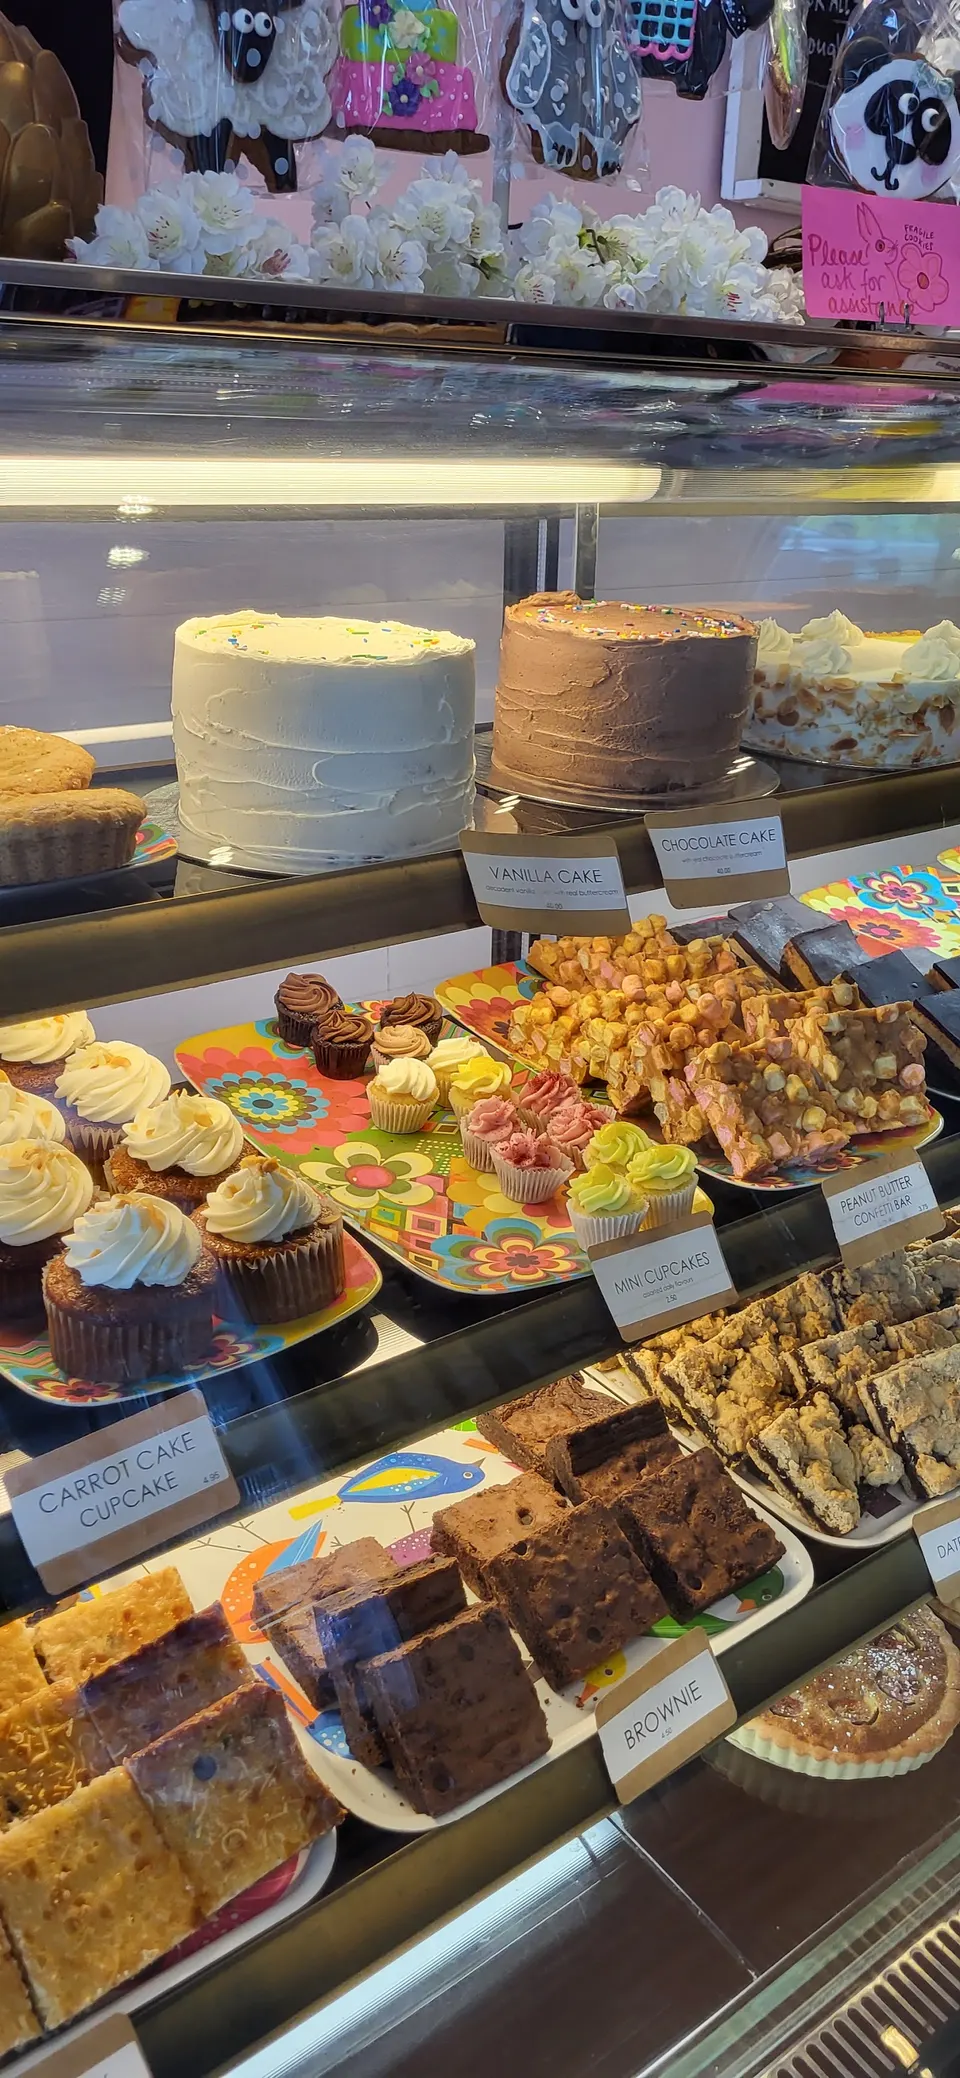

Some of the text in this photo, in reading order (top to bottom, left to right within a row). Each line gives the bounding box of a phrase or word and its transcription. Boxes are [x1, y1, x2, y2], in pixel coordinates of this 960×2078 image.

[904, 224, 935, 240] FRAGILE
[904, 234, 934, 251] COOKIES
[808, 233, 870, 267] Please
[821, 266, 887, 299] ask for
[661, 828, 777, 852] CHOCOLATE CAKE
[488, 865, 604, 884] VANILLA CAKE
[840, 1174, 913, 1214] PEANUT BUTTER
[853, 1202, 894, 1227] CONFETTI
[893, 1194, 913, 1211] BAR
[614, 1250, 710, 1295] MINI CUPCAKES
[38, 1431, 196, 1514] CARROT CAKE
[79, 1470, 179, 1528] CUPCAKE
[623, 1679, 703, 1750] BROWNIE
